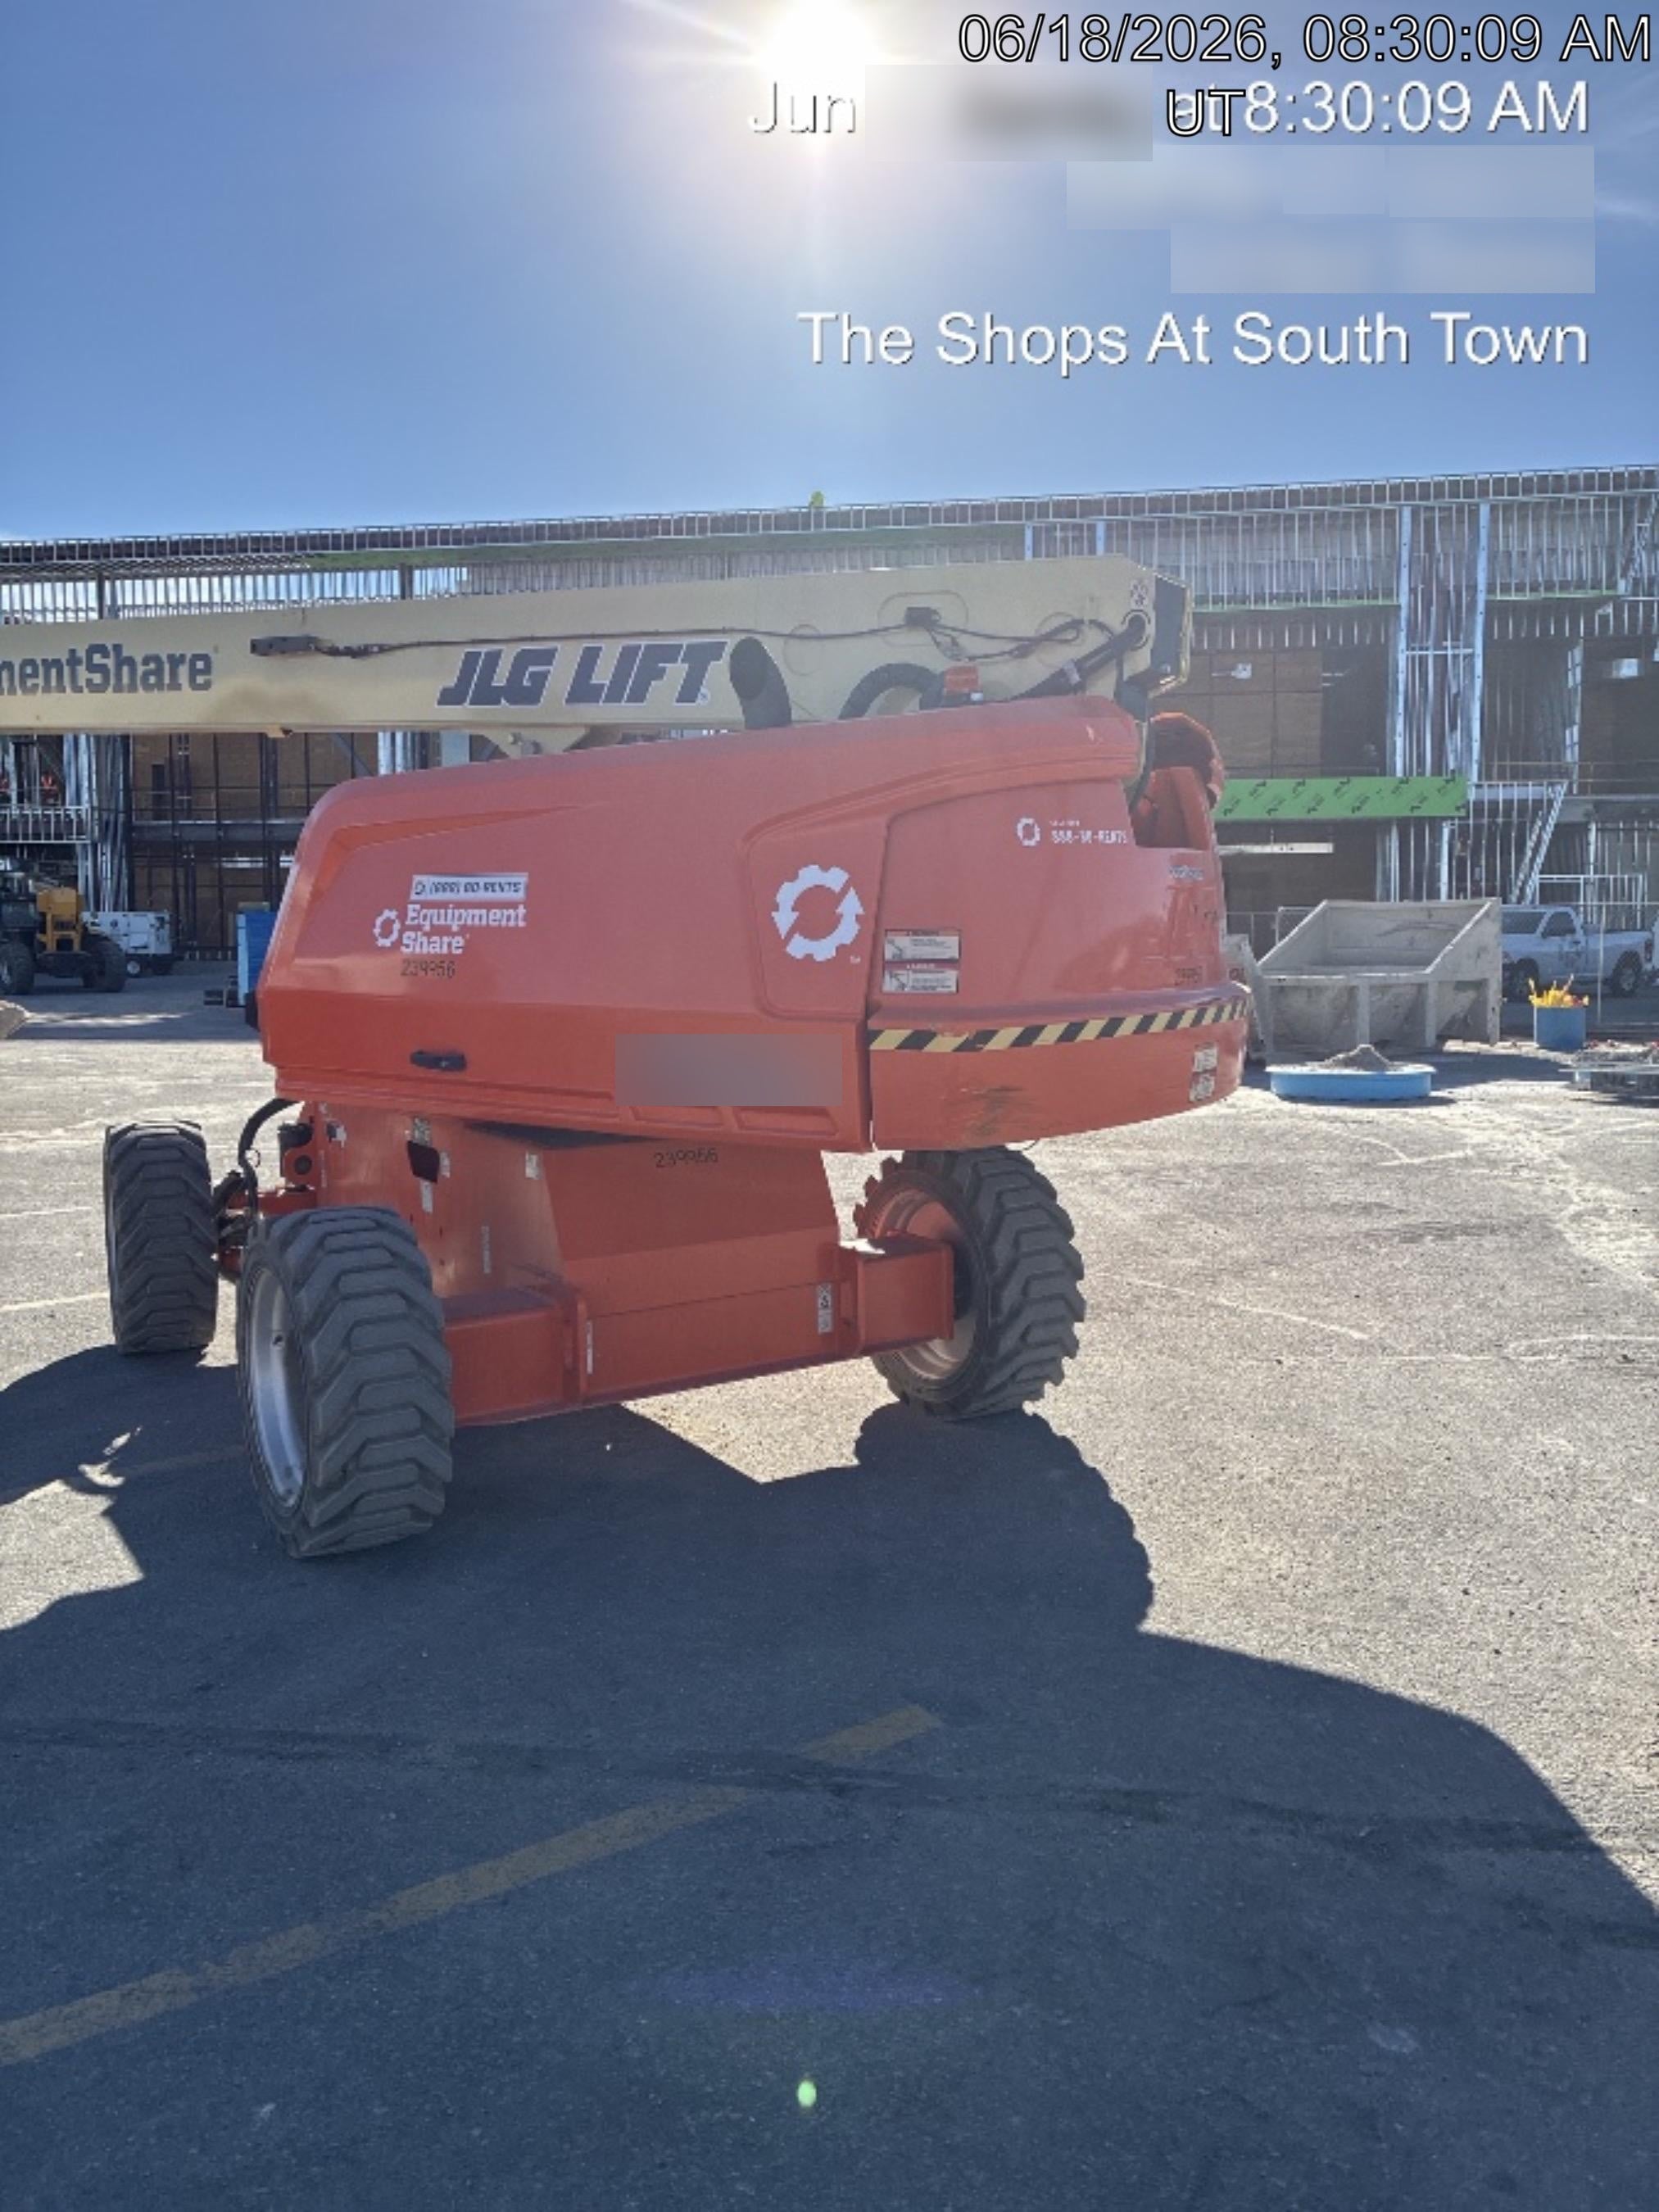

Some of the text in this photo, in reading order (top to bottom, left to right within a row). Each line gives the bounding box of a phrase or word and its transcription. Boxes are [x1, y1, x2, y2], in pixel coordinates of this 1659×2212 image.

[435, 639, 730, 708] JLG LIFT
[405, 904, 527, 931] Equipment
[400, 931, 465, 954] Share
